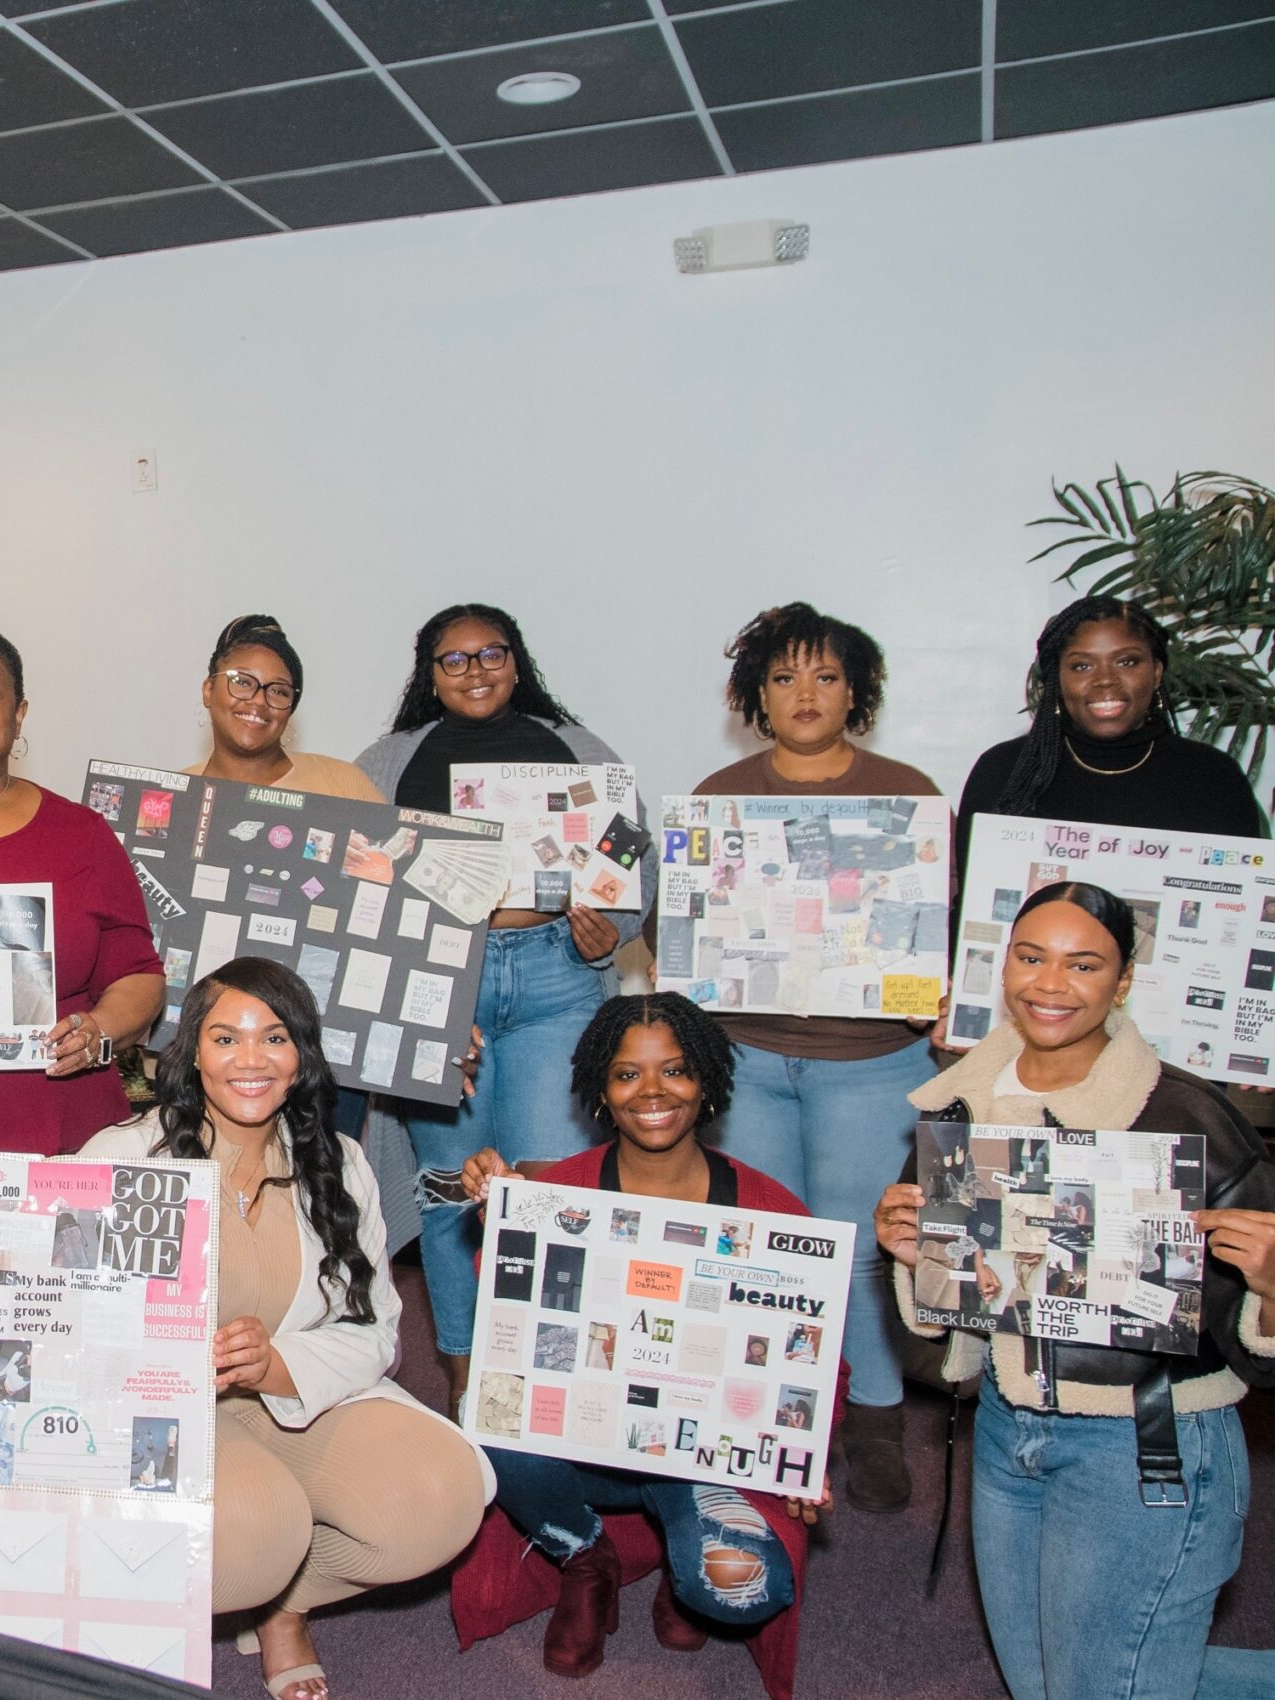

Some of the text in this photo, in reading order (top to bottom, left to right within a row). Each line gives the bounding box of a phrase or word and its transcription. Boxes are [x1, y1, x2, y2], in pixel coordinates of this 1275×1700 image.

[91, 762, 189, 788] HEALTHY LIVING
[501, 765, 589, 780] DISCIPLINE
[249, 788, 303, 807] #ADULTING
[756, 801, 789, 813] Winner
[801, 800, 813, 815] by
[194, 786, 214, 858] QUEEN
[1001, 826, 1090, 842] 2024 The
[1045, 842, 1089, 860] Year
[1098, 838, 1121, 853] of
[1133, 840, 1170, 860] Joy
[1038, 864, 1059, 872] BUT
[1037, 872, 1059, 880] GOD
[1163, 876, 1243, 894] Congratulations
[1215, 902, 1246, 912] enough
[256, 922, 289, 937] 2024
[1237, 1004, 1253, 1012] MY
[1256, 998, 1267, 1006] IN
[1235, 1018, 1263, 1029] IN MY
[1237, 1012, 1255, 1020] BUT
[1234, 1026, 1261, 1036] BIBLE
[975, 1126, 1055, 1140] BE YOUR OWN
[1059, 1132, 1095, 1146] LOVE
[33, 1178, 99, 1191] YOU'RE HER
[111, 1168, 189, 1205] GOD
[993, 1176, 1018, 1187] health
[501, 1186, 509, 1218] I
[108, 1202, 186, 1238] GOT
[925, 1224, 966, 1234] Take Flight
[1141, 1220, 1169, 1242] THE
[773, 1234, 836, 1257] GLOW
[108, 1233, 181, 1278] ME
[15, 1274, 67, 1288] My bank
[71, 1270, 93, 1281] I am
[635, 1267, 673, 1280] WINNER
[645, 1276, 655, 1284] BY
[701, 1264, 805, 1285] BE YOUR OWN BOSS
[1100, 1271, 1131, 1282] DEBT
[71, 1281, 122, 1293] millionaire
[167, 1284, 182, 1297] MY
[14, 1291, 63, 1302] account
[729, 1282, 825, 1318] beauty
[14, 1306, 52, 1319] grows
[145, 1303, 205, 1318] BUSINESS IS
[1037, 1298, 1108, 1316] WORTH
[917, 1308, 997, 1330] Black Love
[1037, 1310, 1075, 1325] THE
[13, 1321, 73, 1336] every day
[630, 1309, 673, 1343] Am
[1037, 1322, 1079, 1338] TRIP
[507, 1346, 517, 1354] day
[632, 1347, 671, 1365] 2024
[137, 1370, 159, 1378] YOU
[141, 1394, 175, 1402] MADE.
[43, 1416, 79, 1434] 810
[675, 1417, 813, 1488] ENOUGH
